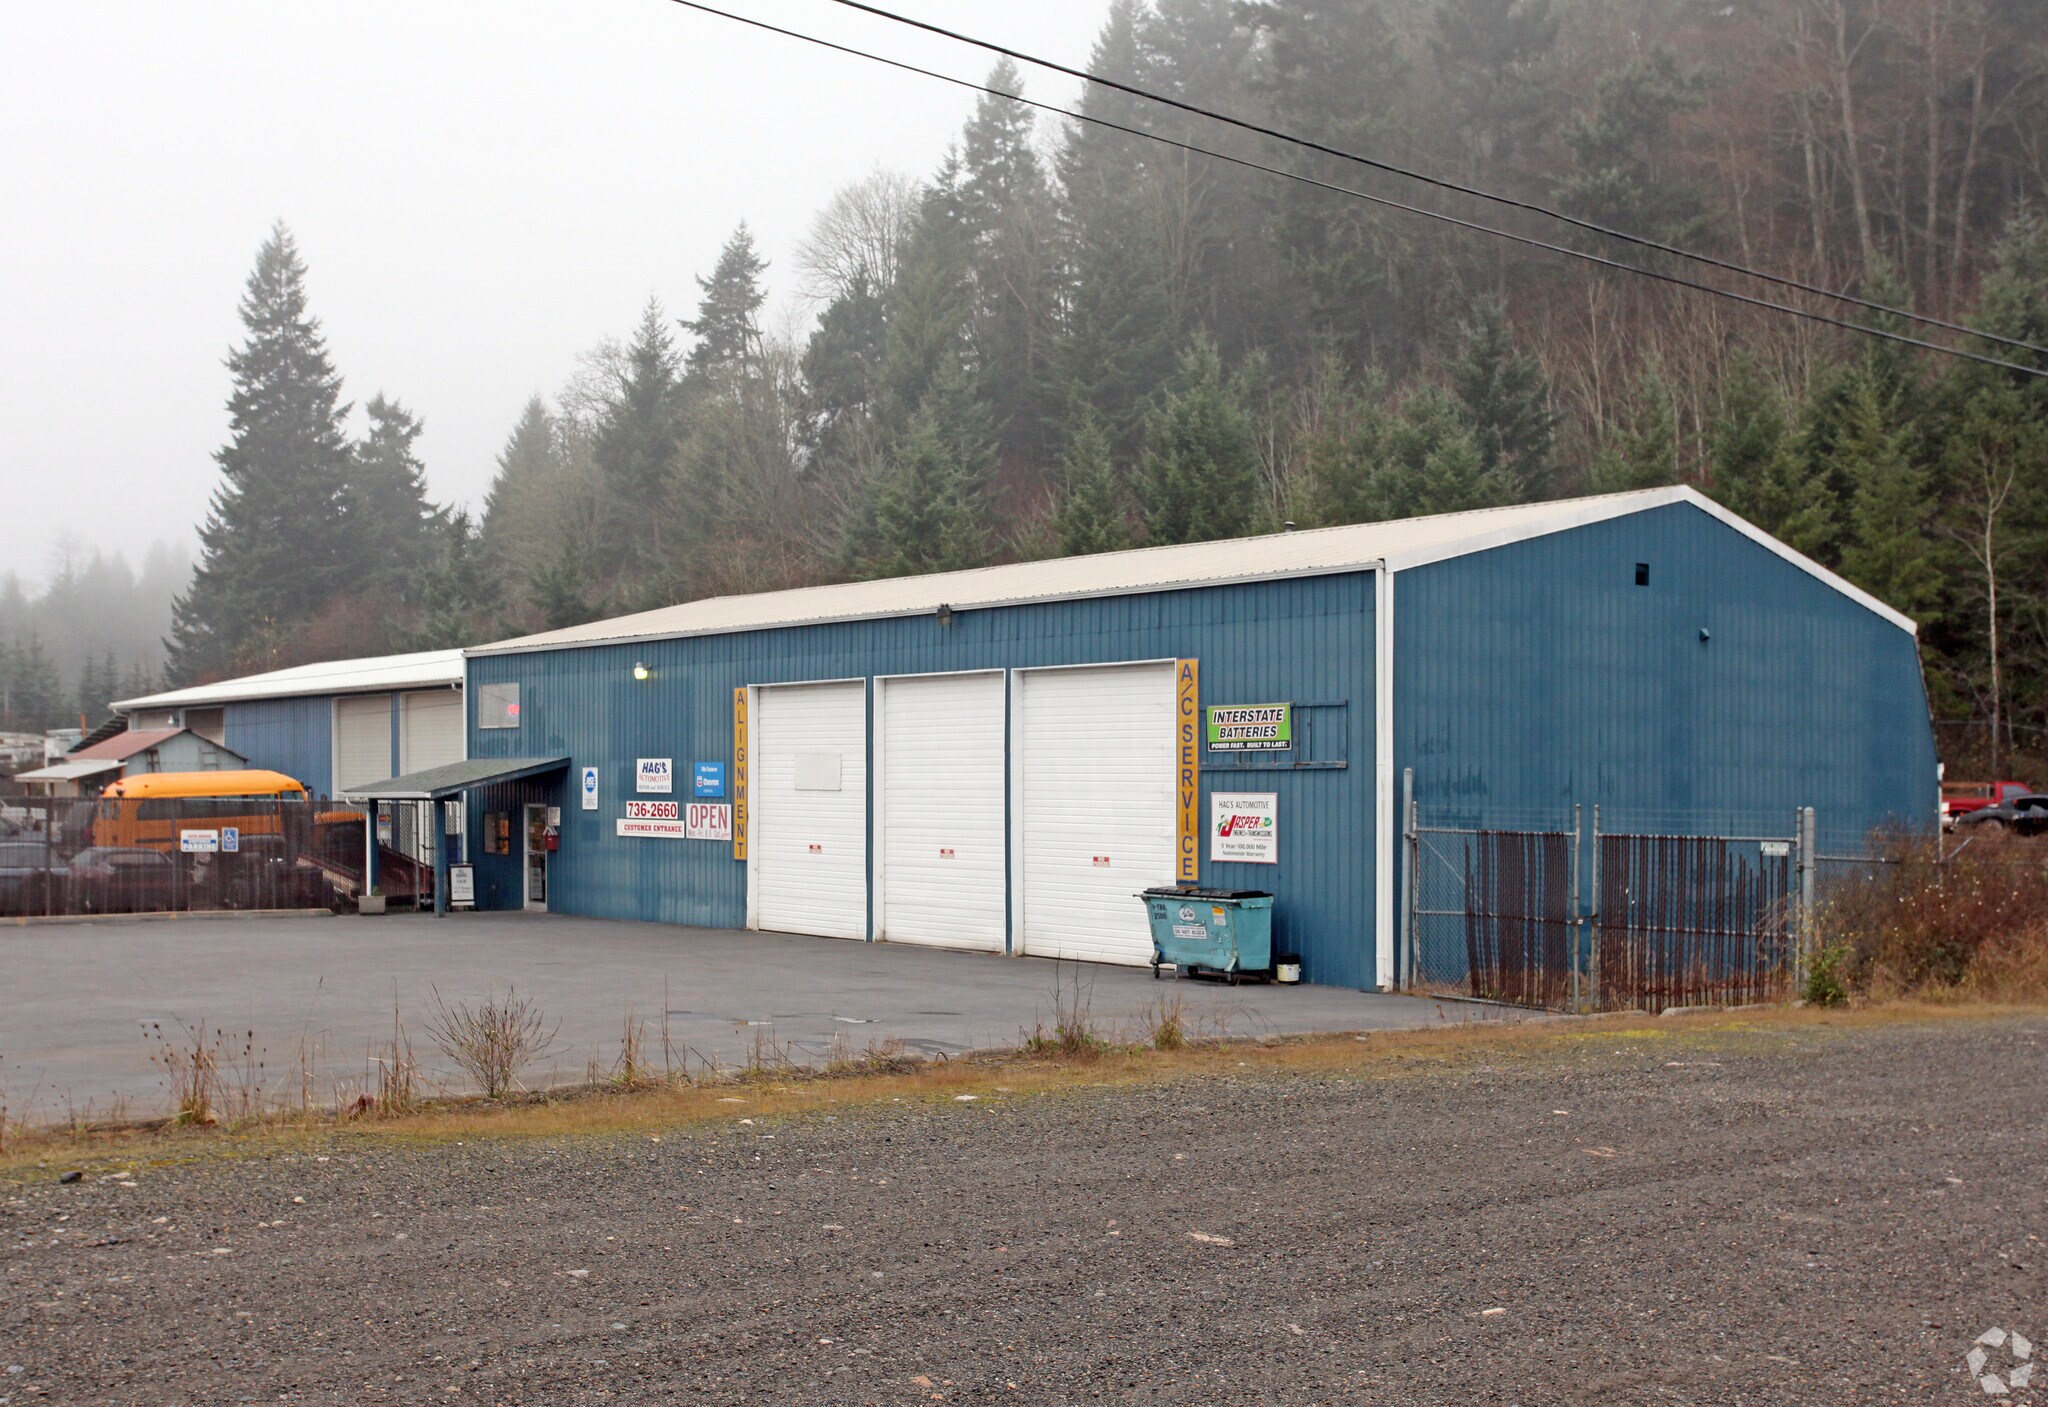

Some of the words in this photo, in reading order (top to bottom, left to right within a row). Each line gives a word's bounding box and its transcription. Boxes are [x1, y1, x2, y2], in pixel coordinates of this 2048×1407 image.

[1181, 663, 1193, 716] A/C
[1213, 709, 1283, 723] INTERSTATE
[1219, 726, 1277, 738] BATTERIES
[642, 762, 667, 774] HAG'S
[736, 691, 745, 857] ALIGNMENT
[639, 773, 670, 783] AUTOMOTIVE
[1182, 724, 1194, 876] SERVICE
[1235, 801, 1269, 809] AUTOMOTIVE
[690, 805, 727, 829] OPEN
[624, 824, 652, 832] CUSTOMER
[653, 825, 682, 833] ENTRANCE
[1220, 815, 1260, 837] JASPER
